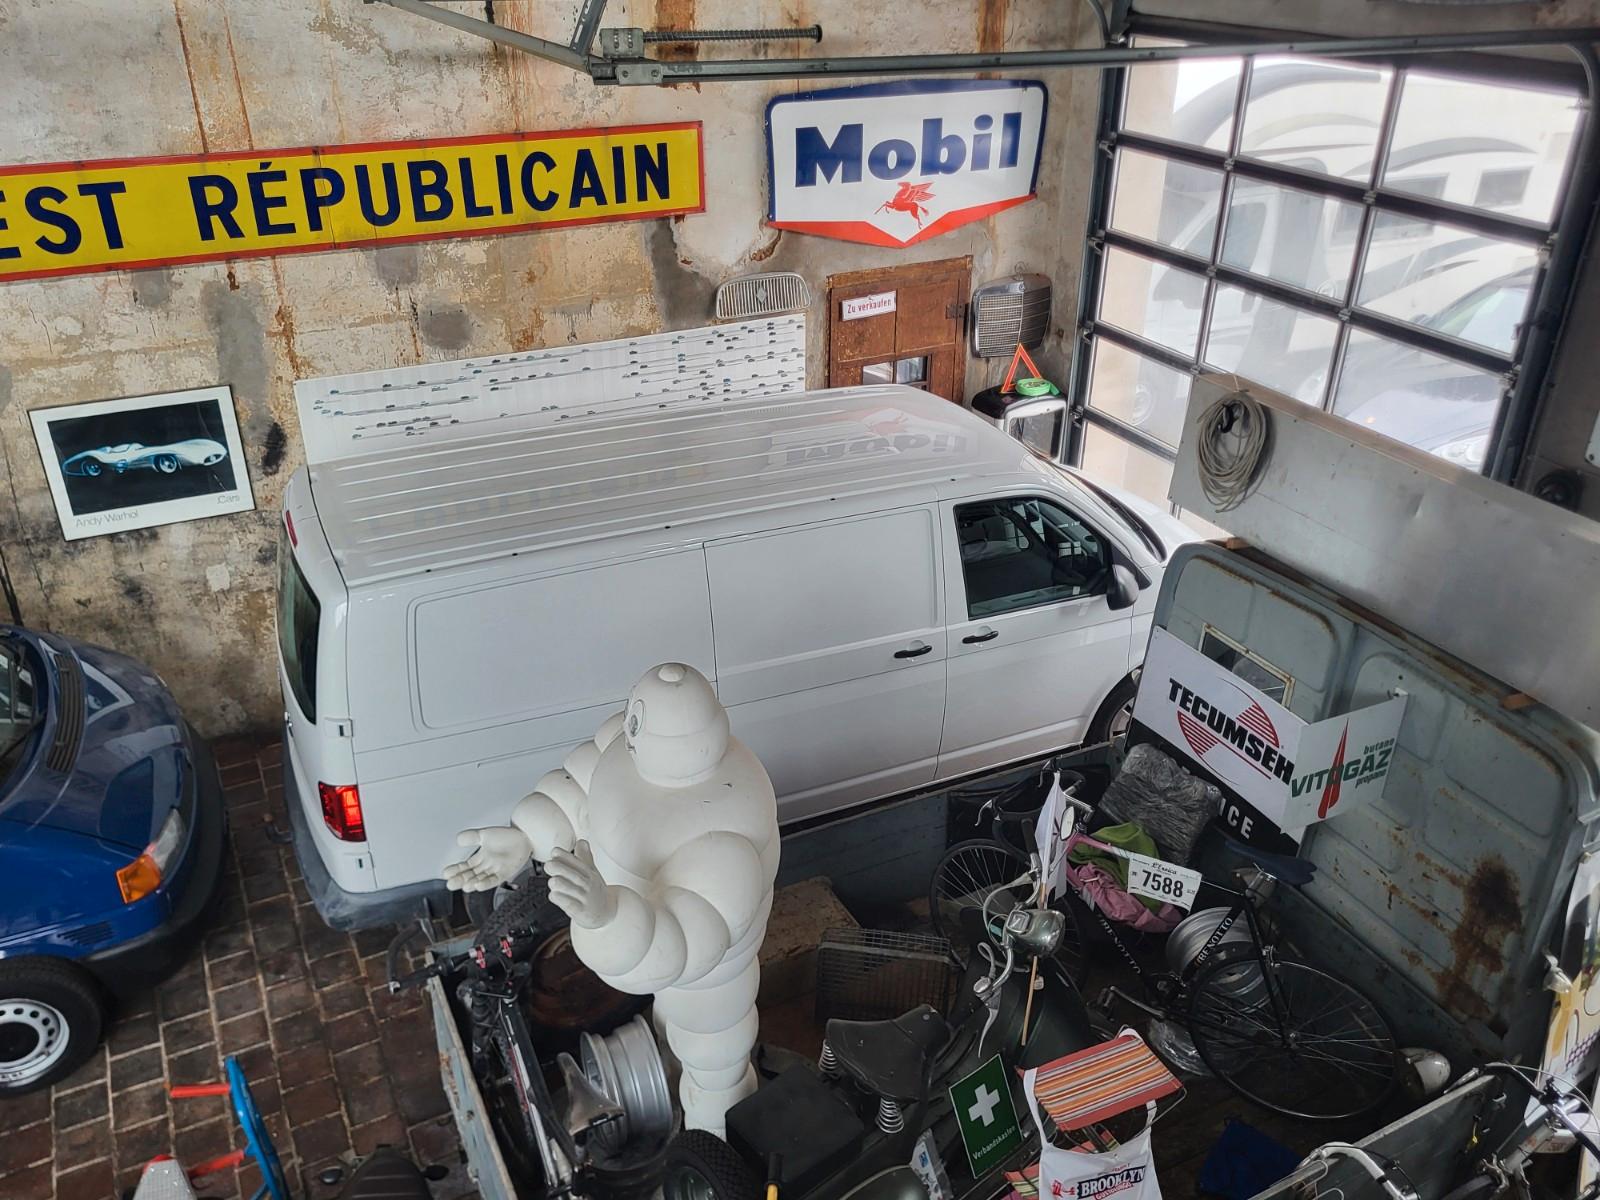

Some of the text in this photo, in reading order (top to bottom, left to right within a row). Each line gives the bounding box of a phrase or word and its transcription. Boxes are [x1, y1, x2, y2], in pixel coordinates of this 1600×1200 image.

[795, 112, 1022, 187] Mobil
[188, 142, 670, 241] RÉPUBLICAIN
[847, 297, 891, 313] Zu verkaufen
[75, 509, 138, 528] Andy Warhol
[1168, 677, 1295, 786] TECUMSEH
[1291, 747, 1392, 798] VITOGAZ
[1142, 869, 1184, 898] 7588
[972, 1125, 1016, 1160] Verbandskasten
[1081, 1167, 1146, 1197] BROOKLYN
